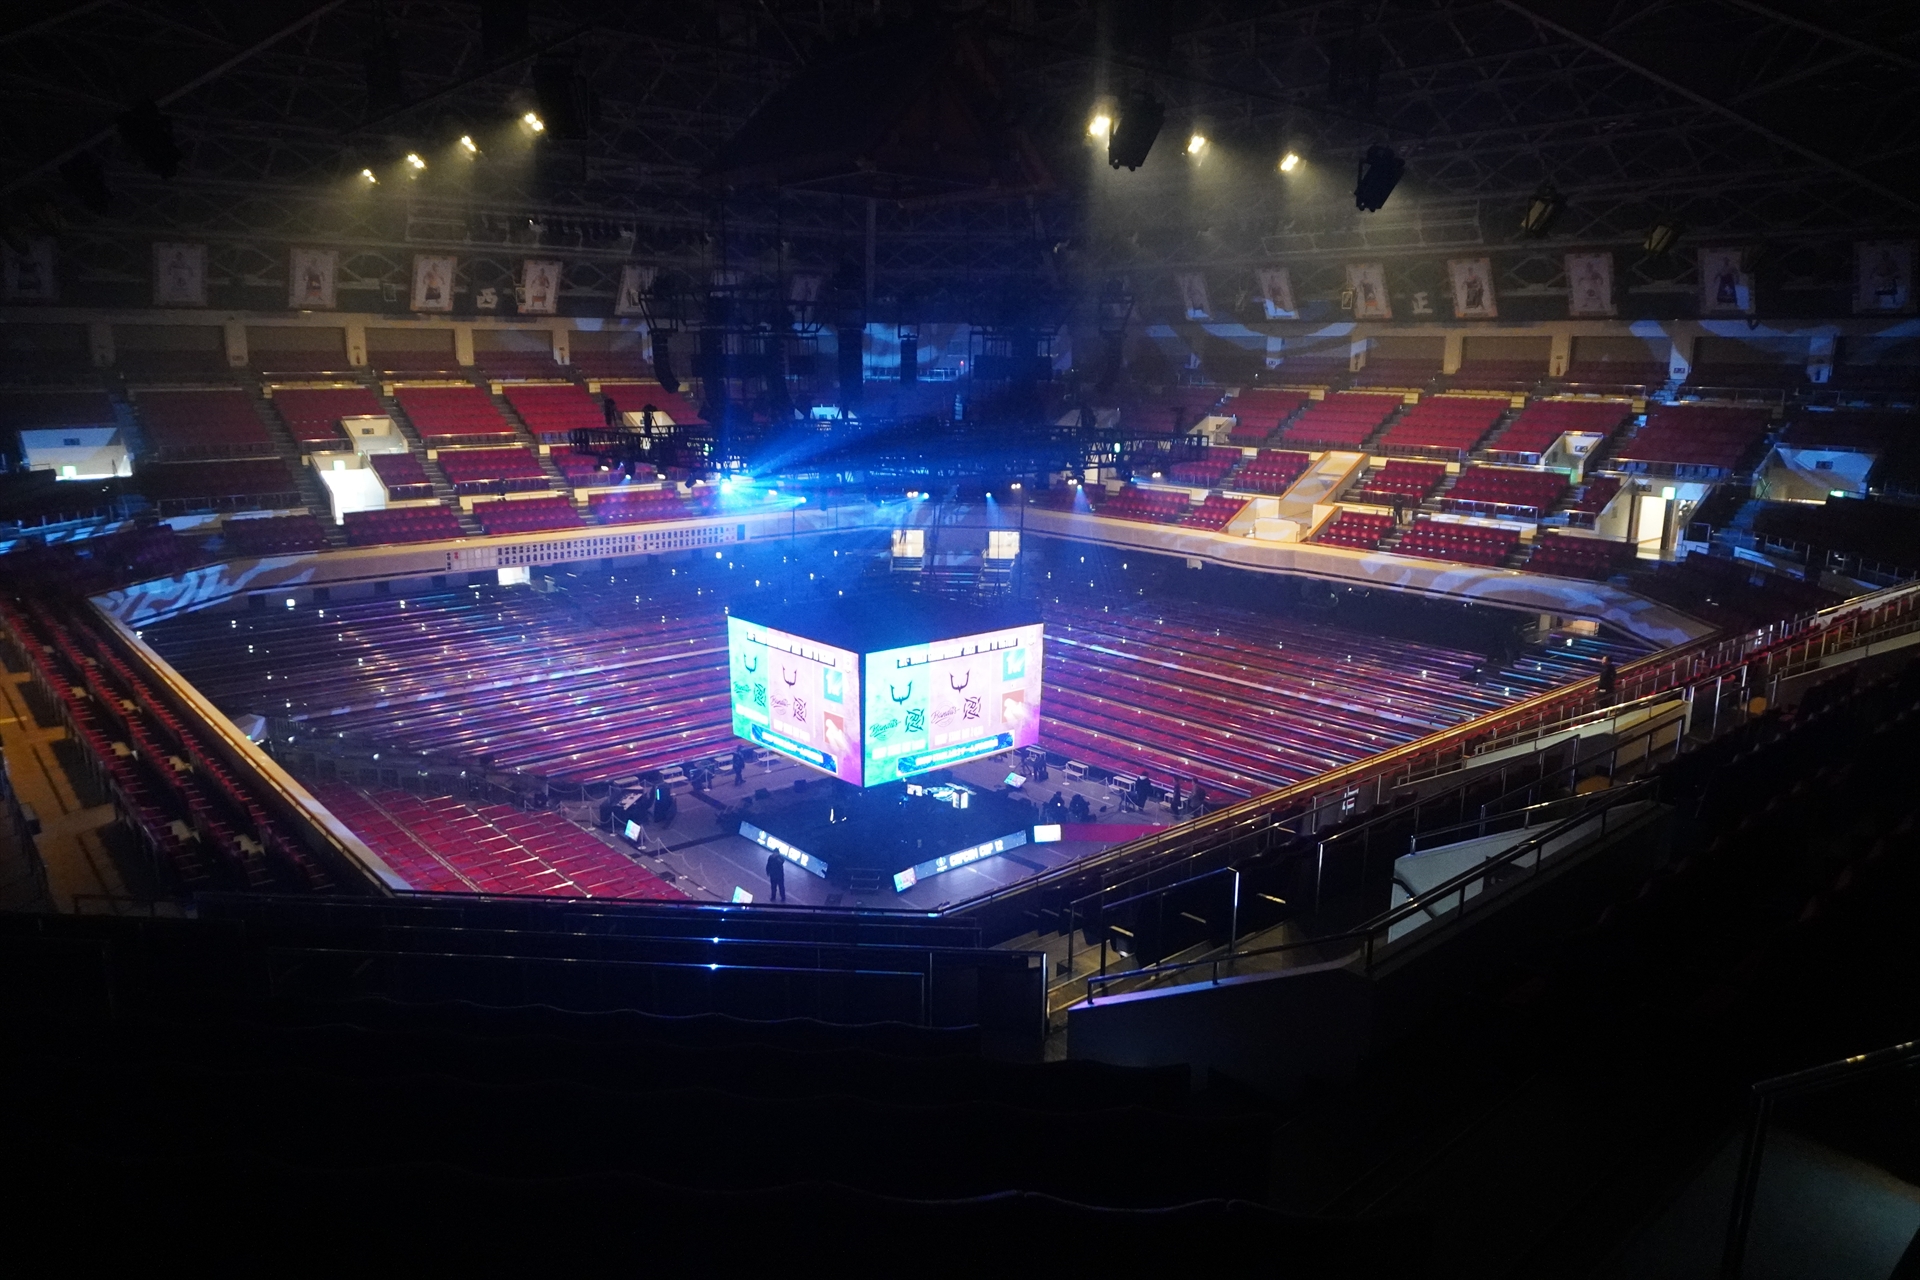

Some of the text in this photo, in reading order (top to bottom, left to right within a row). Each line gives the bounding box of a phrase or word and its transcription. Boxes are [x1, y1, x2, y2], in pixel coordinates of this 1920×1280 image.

[1411, 291, 1433, 314] 正
[949, 840, 1004, 867] CAPCOM CUP 12
